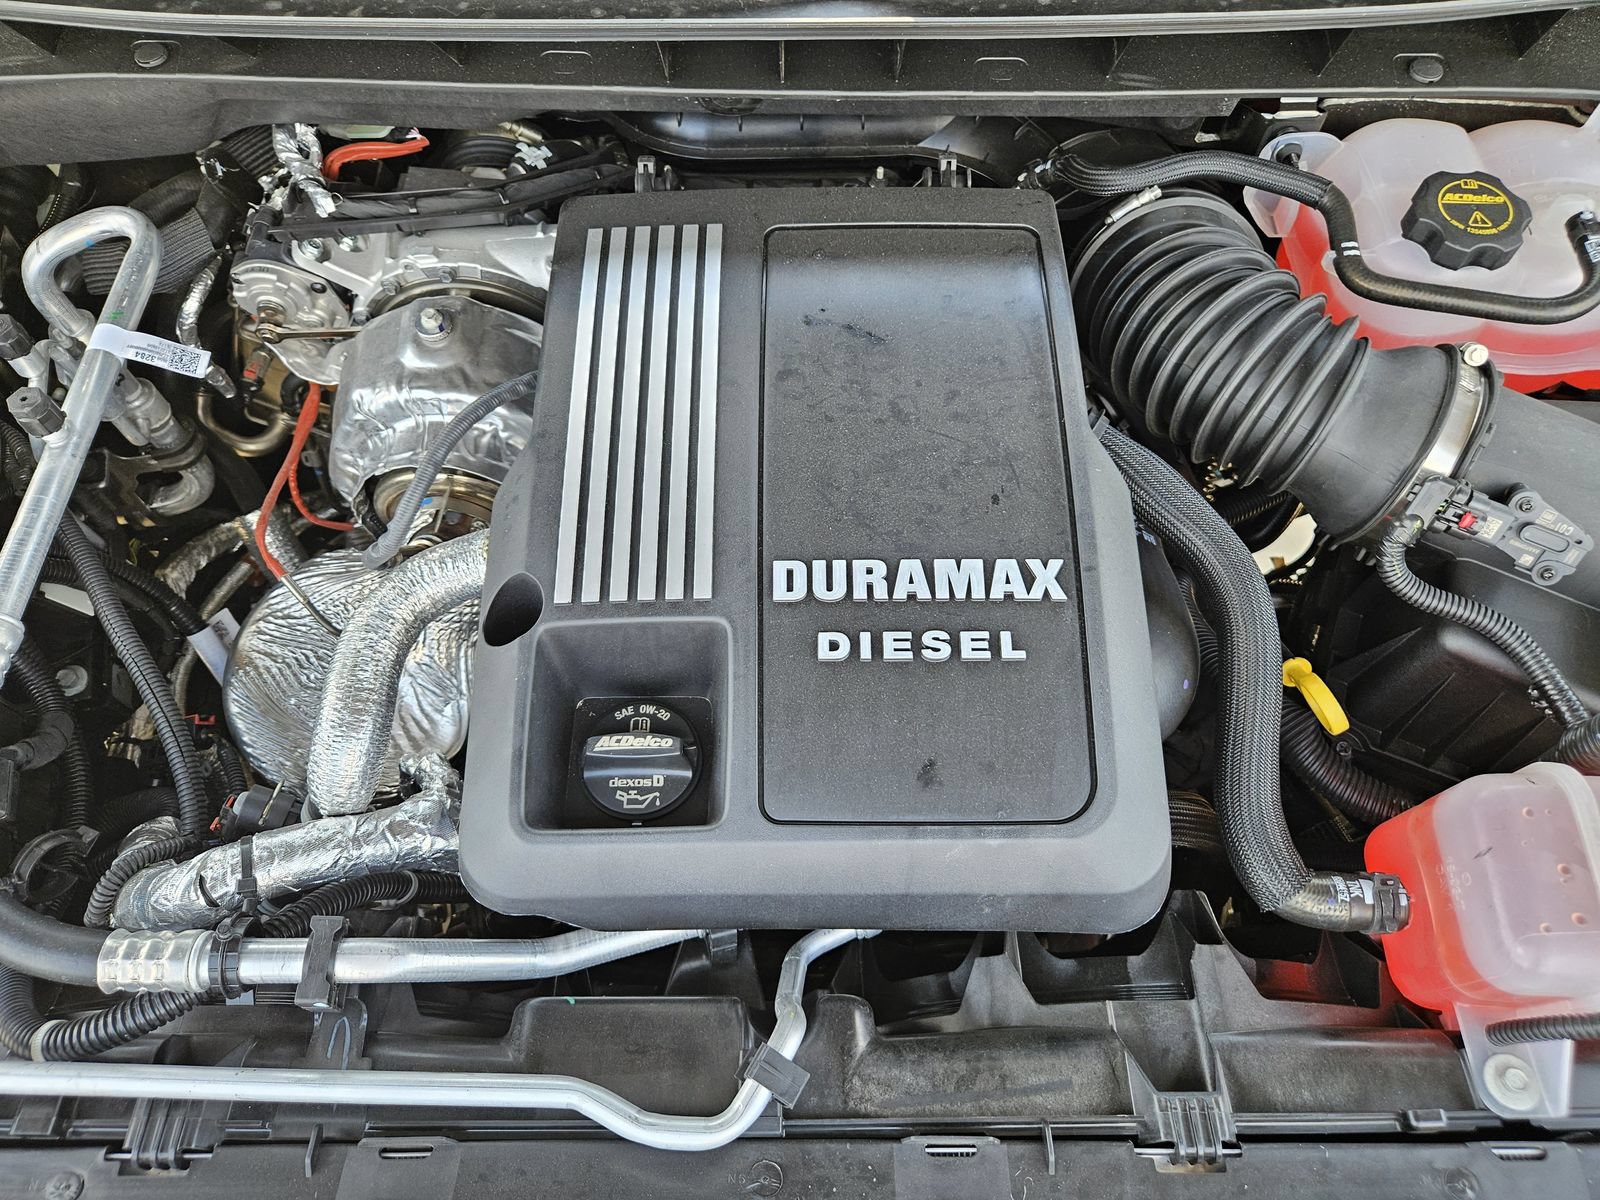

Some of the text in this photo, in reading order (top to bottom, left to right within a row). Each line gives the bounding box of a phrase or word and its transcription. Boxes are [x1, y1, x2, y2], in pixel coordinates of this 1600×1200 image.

[1443, 193, 1505, 203] ACDelco
[135, 351, 157, 363] 3284
[772, 559, 1068, 602] DURAMAX
[817, 630, 1027, 662] DIESEL
[614, 704, 671, 721] SAE 0W-20
[595, 735, 674, 748] ACDelco
[609, 774, 665, 788] dexosD
[1346, 879, 1364, 899] TNK
